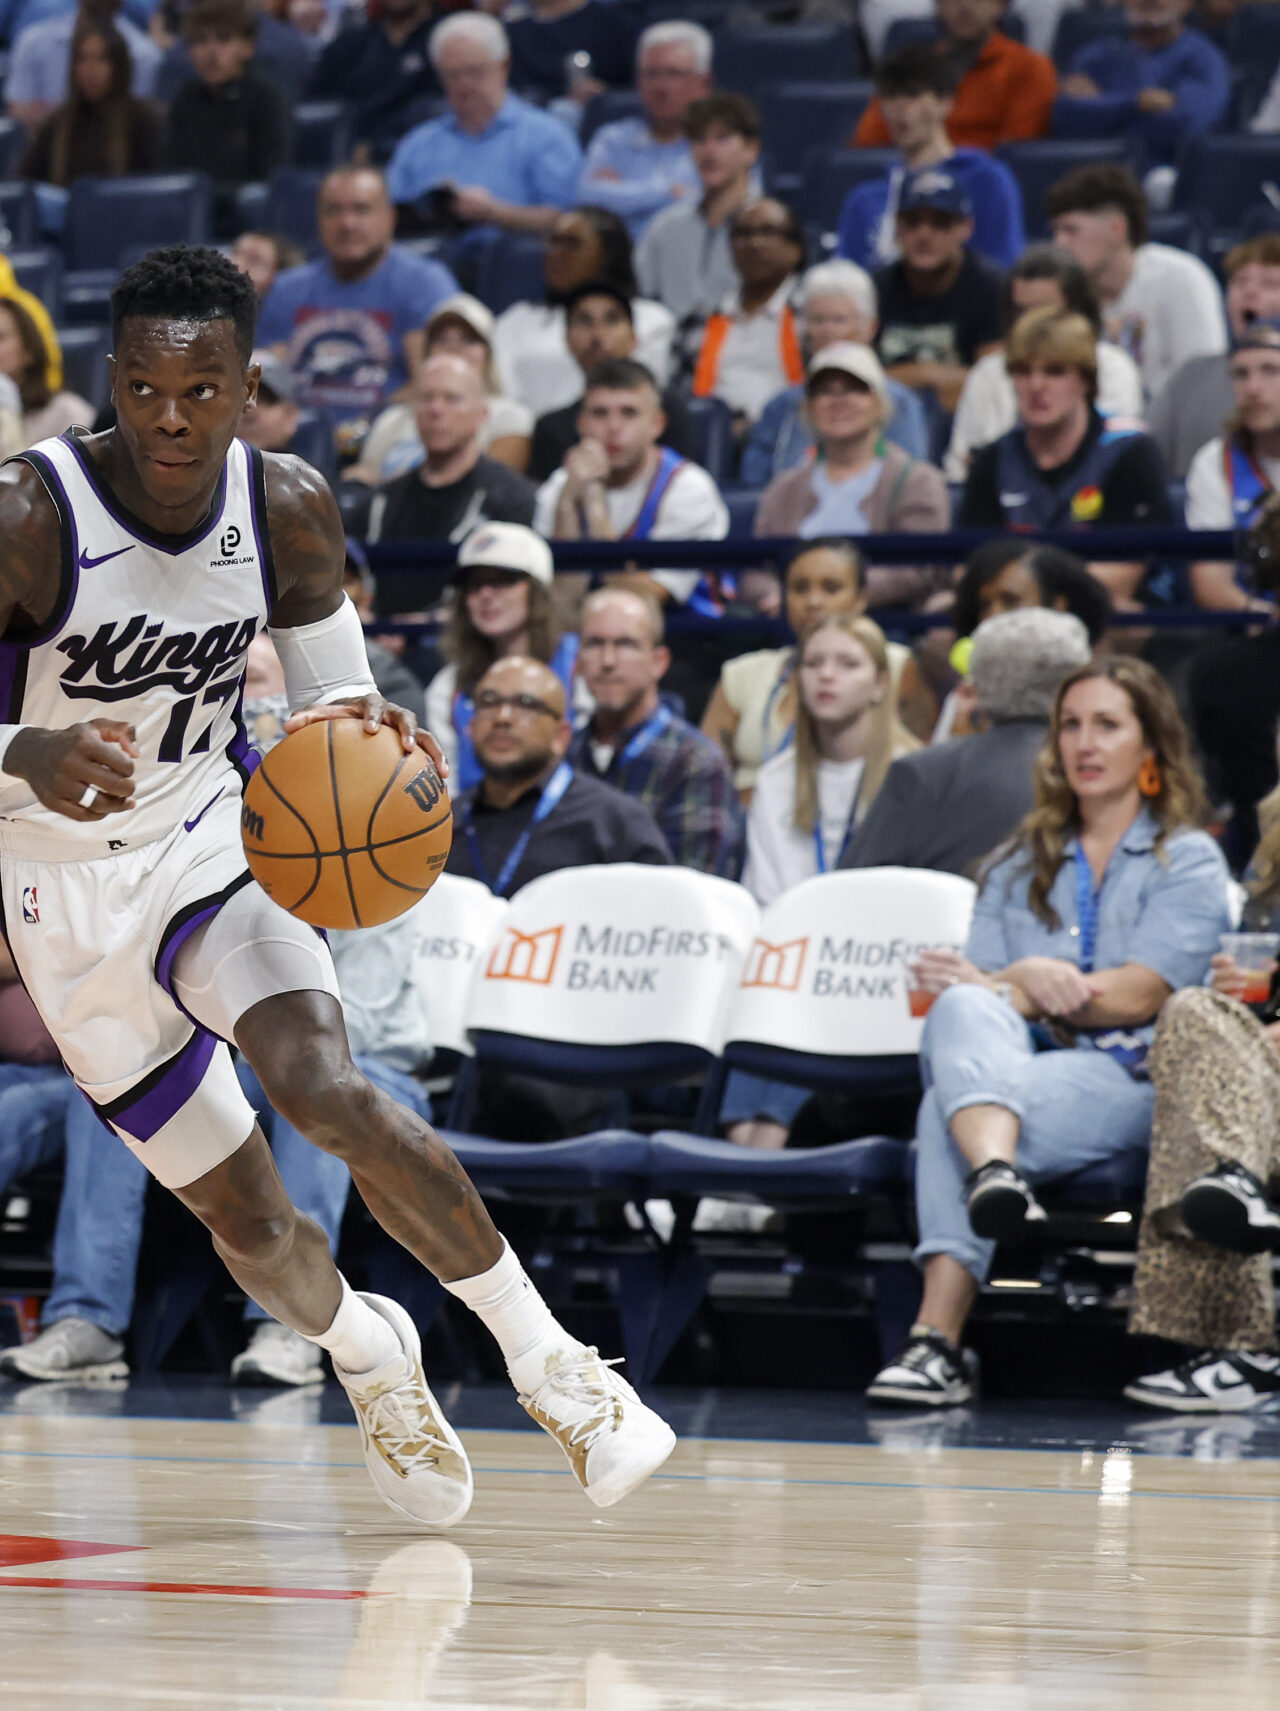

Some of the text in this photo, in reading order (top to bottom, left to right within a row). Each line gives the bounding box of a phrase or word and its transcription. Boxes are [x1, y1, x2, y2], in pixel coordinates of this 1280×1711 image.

[210, 556, 254, 567] PHOONG LAW
[55, 614, 259, 702] Kings
[157, 674, 241, 763] 17
